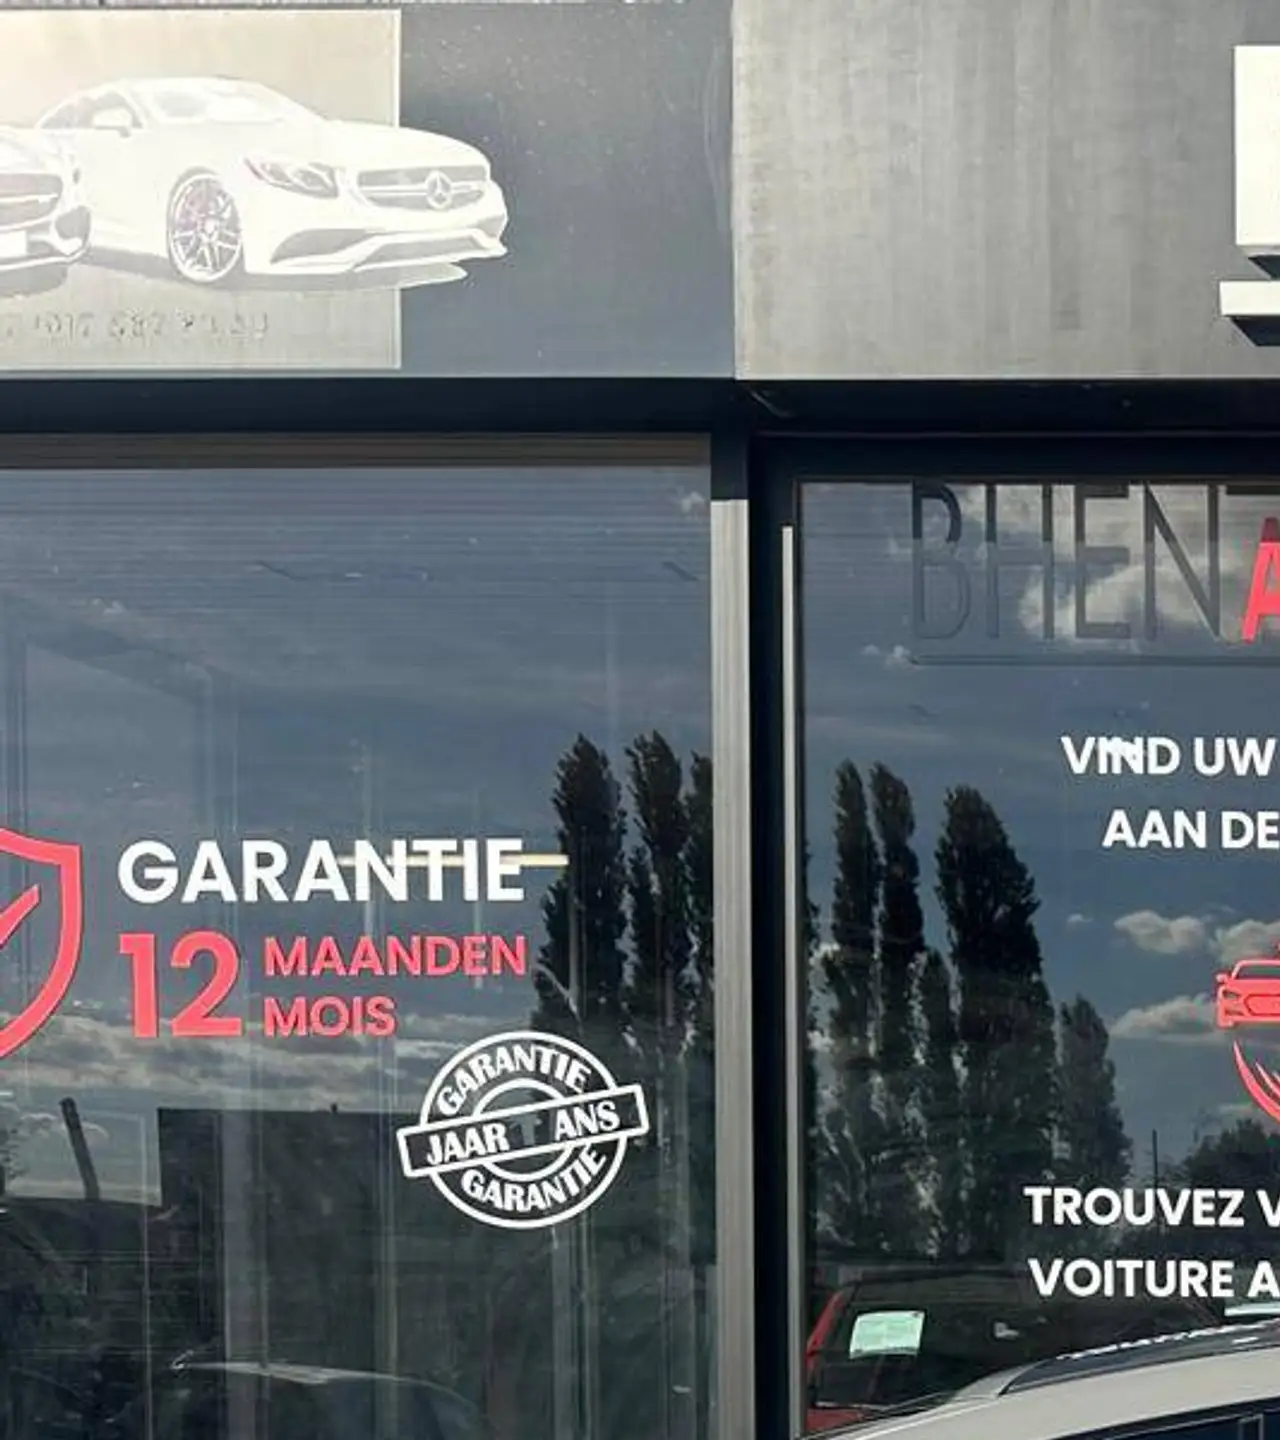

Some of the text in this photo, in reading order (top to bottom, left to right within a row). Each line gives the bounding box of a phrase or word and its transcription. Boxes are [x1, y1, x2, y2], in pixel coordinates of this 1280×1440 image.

[1060, 736, 1180, 775] VIND
[1194, 737, 1276, 776] UW
[1102, 809, 1207, 849] AAN
[1221, 811, 1280, 849] DE
[118, 839, 524, 903] GARANTIE
[264, 935, 527, 976] MAANDEN
[118, 930, 242, 1039] 12
[264, 996, 397, 1038] MOIS
[436, 1043, 593, 1117] GARANTIE
[554, 1099, 621, 1142] ANS
[426, 1122, 510, 1166] JAAR
[460, 1147, 608, 1213] GARANTIE
[1024, 1187, 1244, 1226] TROUVEZ
[1028, 1259, 1234, 1298] VOITURE
